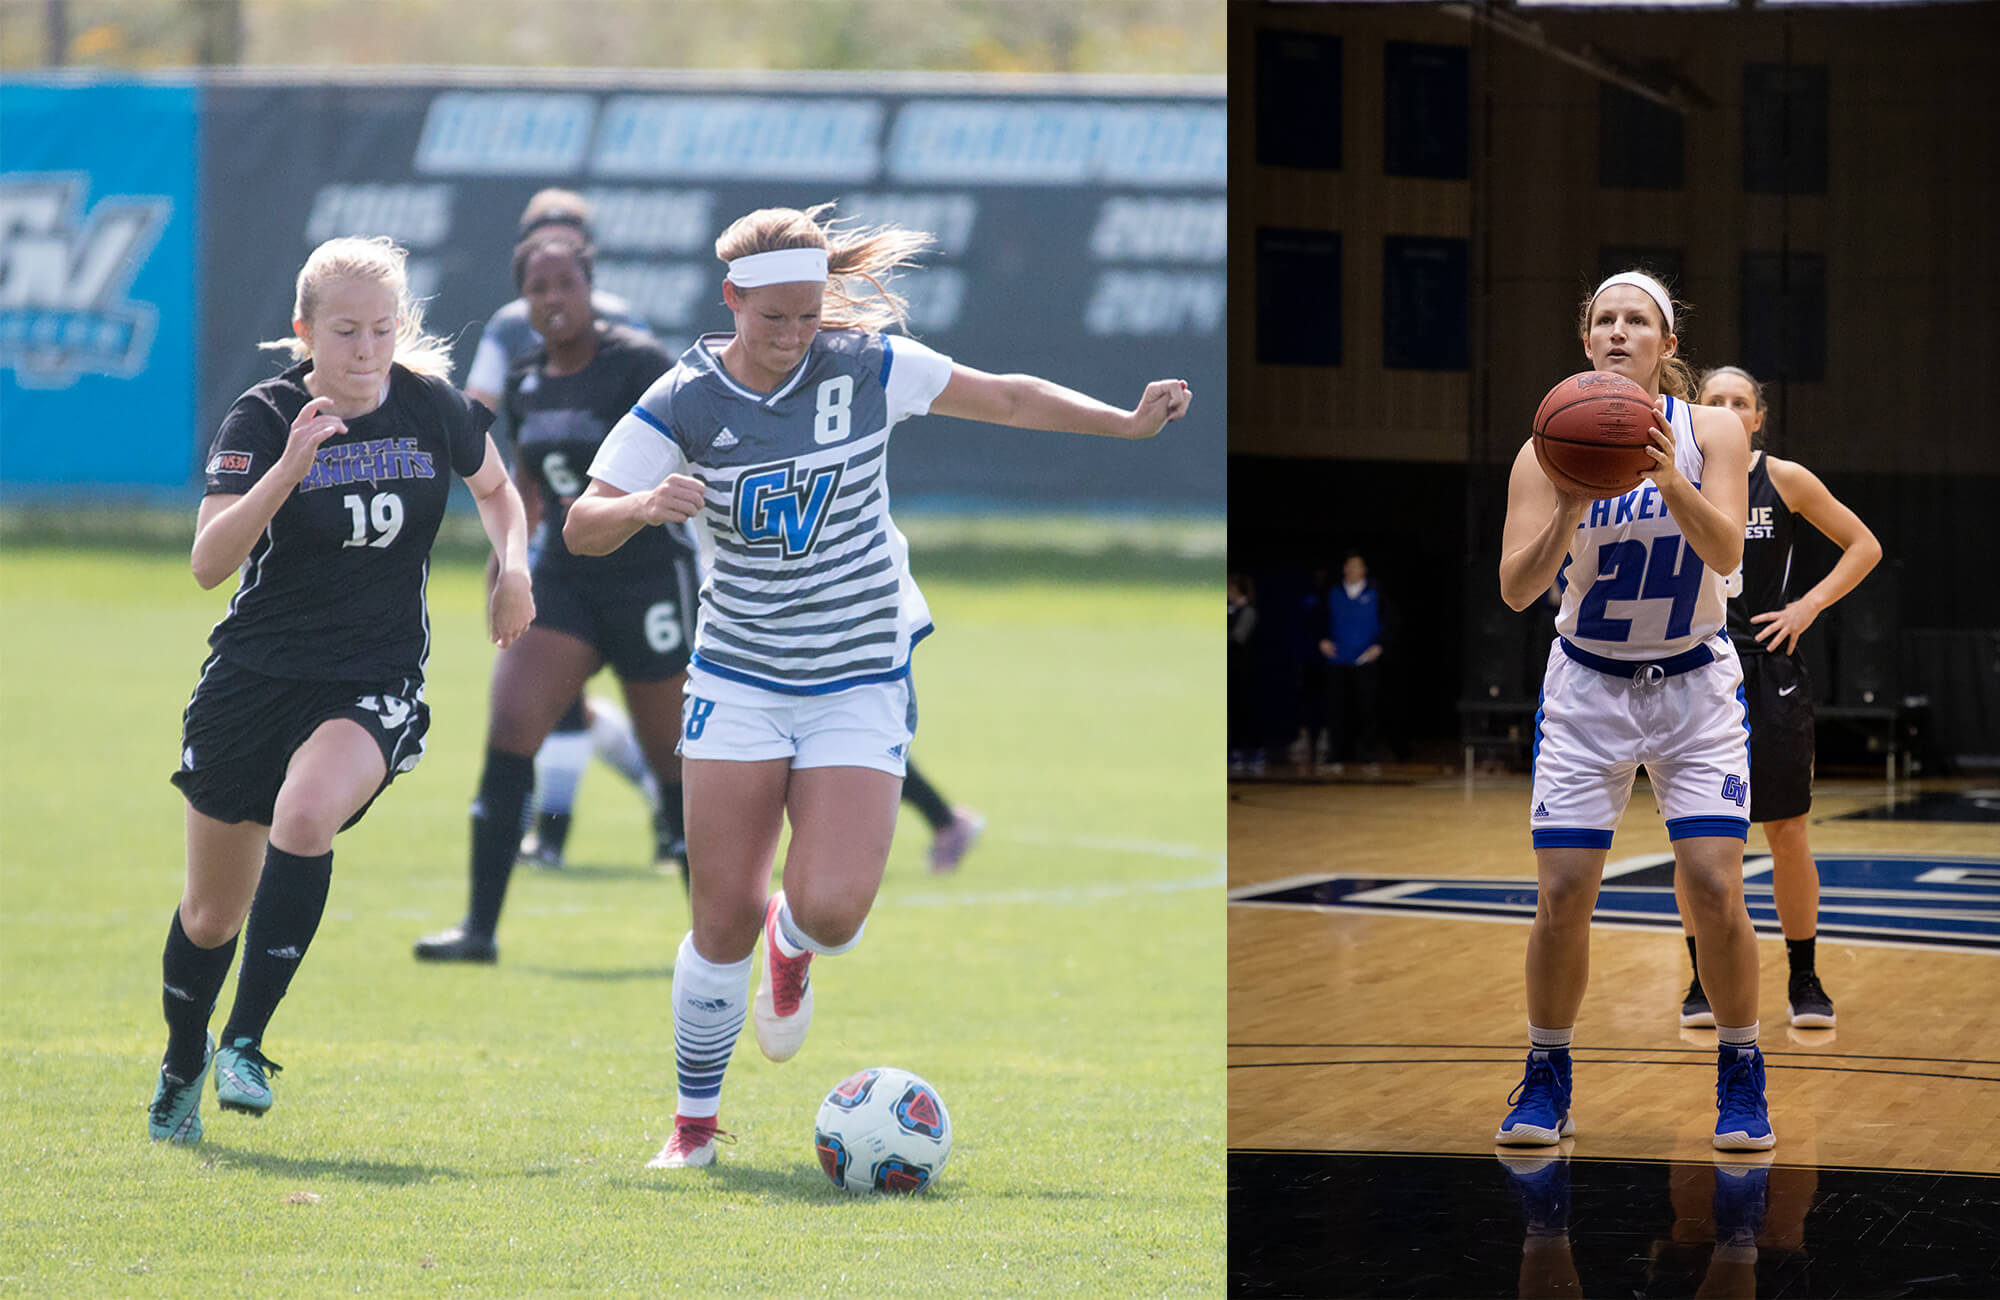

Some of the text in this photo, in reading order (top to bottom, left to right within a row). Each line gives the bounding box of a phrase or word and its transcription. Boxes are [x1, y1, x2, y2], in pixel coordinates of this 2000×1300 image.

[814, 374, 854, 445] 8
[299, 451, 436, 490] KNIGHTS
[316, 437, 418, 462] PURPLE
[541, 452, 579, 496] 6
[343, 492, 404, 549] 19
[731, 460, 846, 561] GV
[1574, 534, 1704, 642] 24
[644, 601, 682, 654] 6
[686, 697, 715, 740] 8
[1721, 773, 1748, 808] GV
